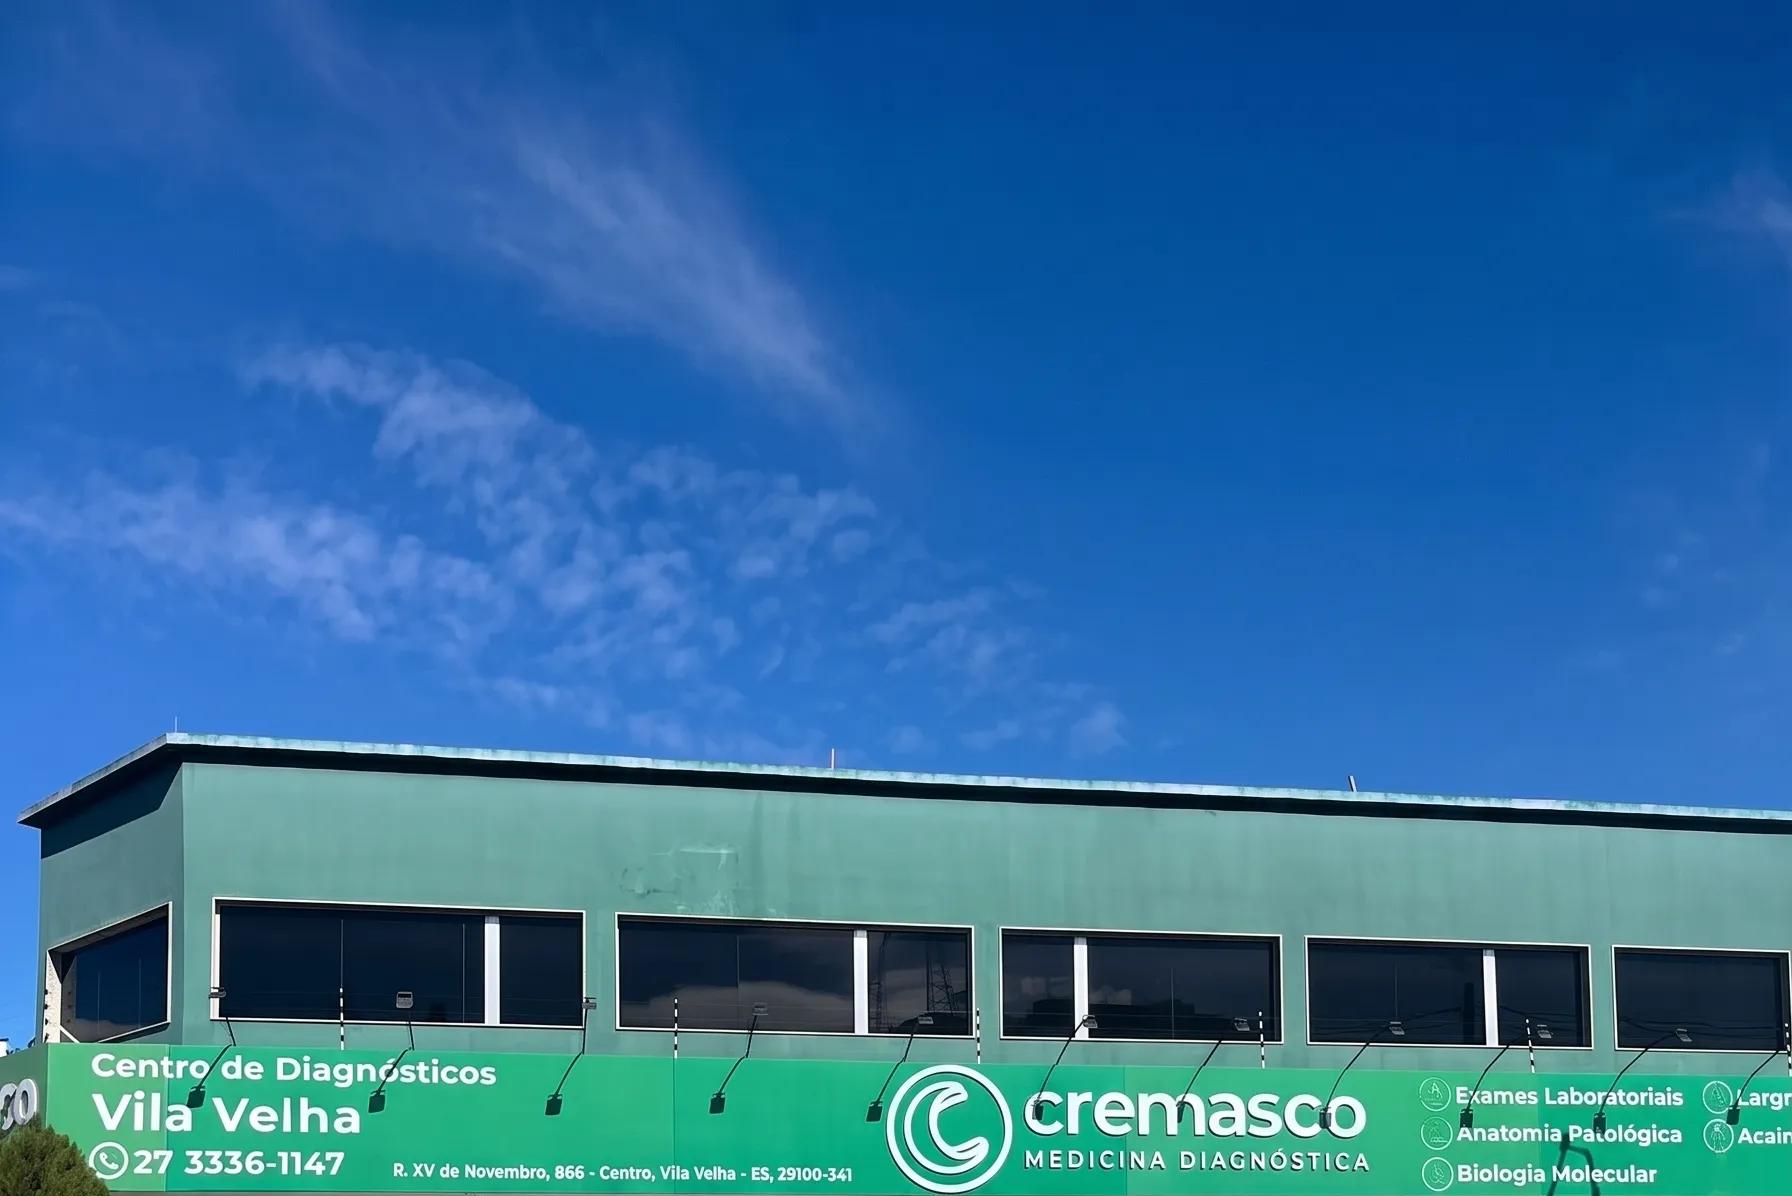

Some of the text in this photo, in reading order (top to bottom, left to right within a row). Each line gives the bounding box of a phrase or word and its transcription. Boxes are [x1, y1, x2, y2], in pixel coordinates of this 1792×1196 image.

[91, 1053, 497, 1088] Centro de Diagnósticos
[1456, 1086, 1684, 1106] Exames Laboratoriais
[91, 1090, 361, 1134] Vila Velha
[1023, 1090, 1367, 1138] cremasco
[1456, 1124, 1562, 1142] Anatomia
[133, 1149, 345, 1176] 27 3336-1147
[1024, 1148, 1370, 1171] MEDICINA DIAGNÓSTICA
[393, 1163, 408, 1178] R.
[412, 1163, 436, 1178] XV
[439, 1163, 460, 1178] de
[464, 1164, 550, 1182] Novembro,
[554, 1165, 585, 1180] 866
[599, 1165, 656, 1182] Centro,
[660, 1165, 690, 1181] Vila
[694, 1166, 736, 1181] Velha
[751, 1166, 774, 1183] ES,
[777, 1167, 852, 1182] 29100-341
[1457, 1163, 1658, 1187] Biologia Molecular
